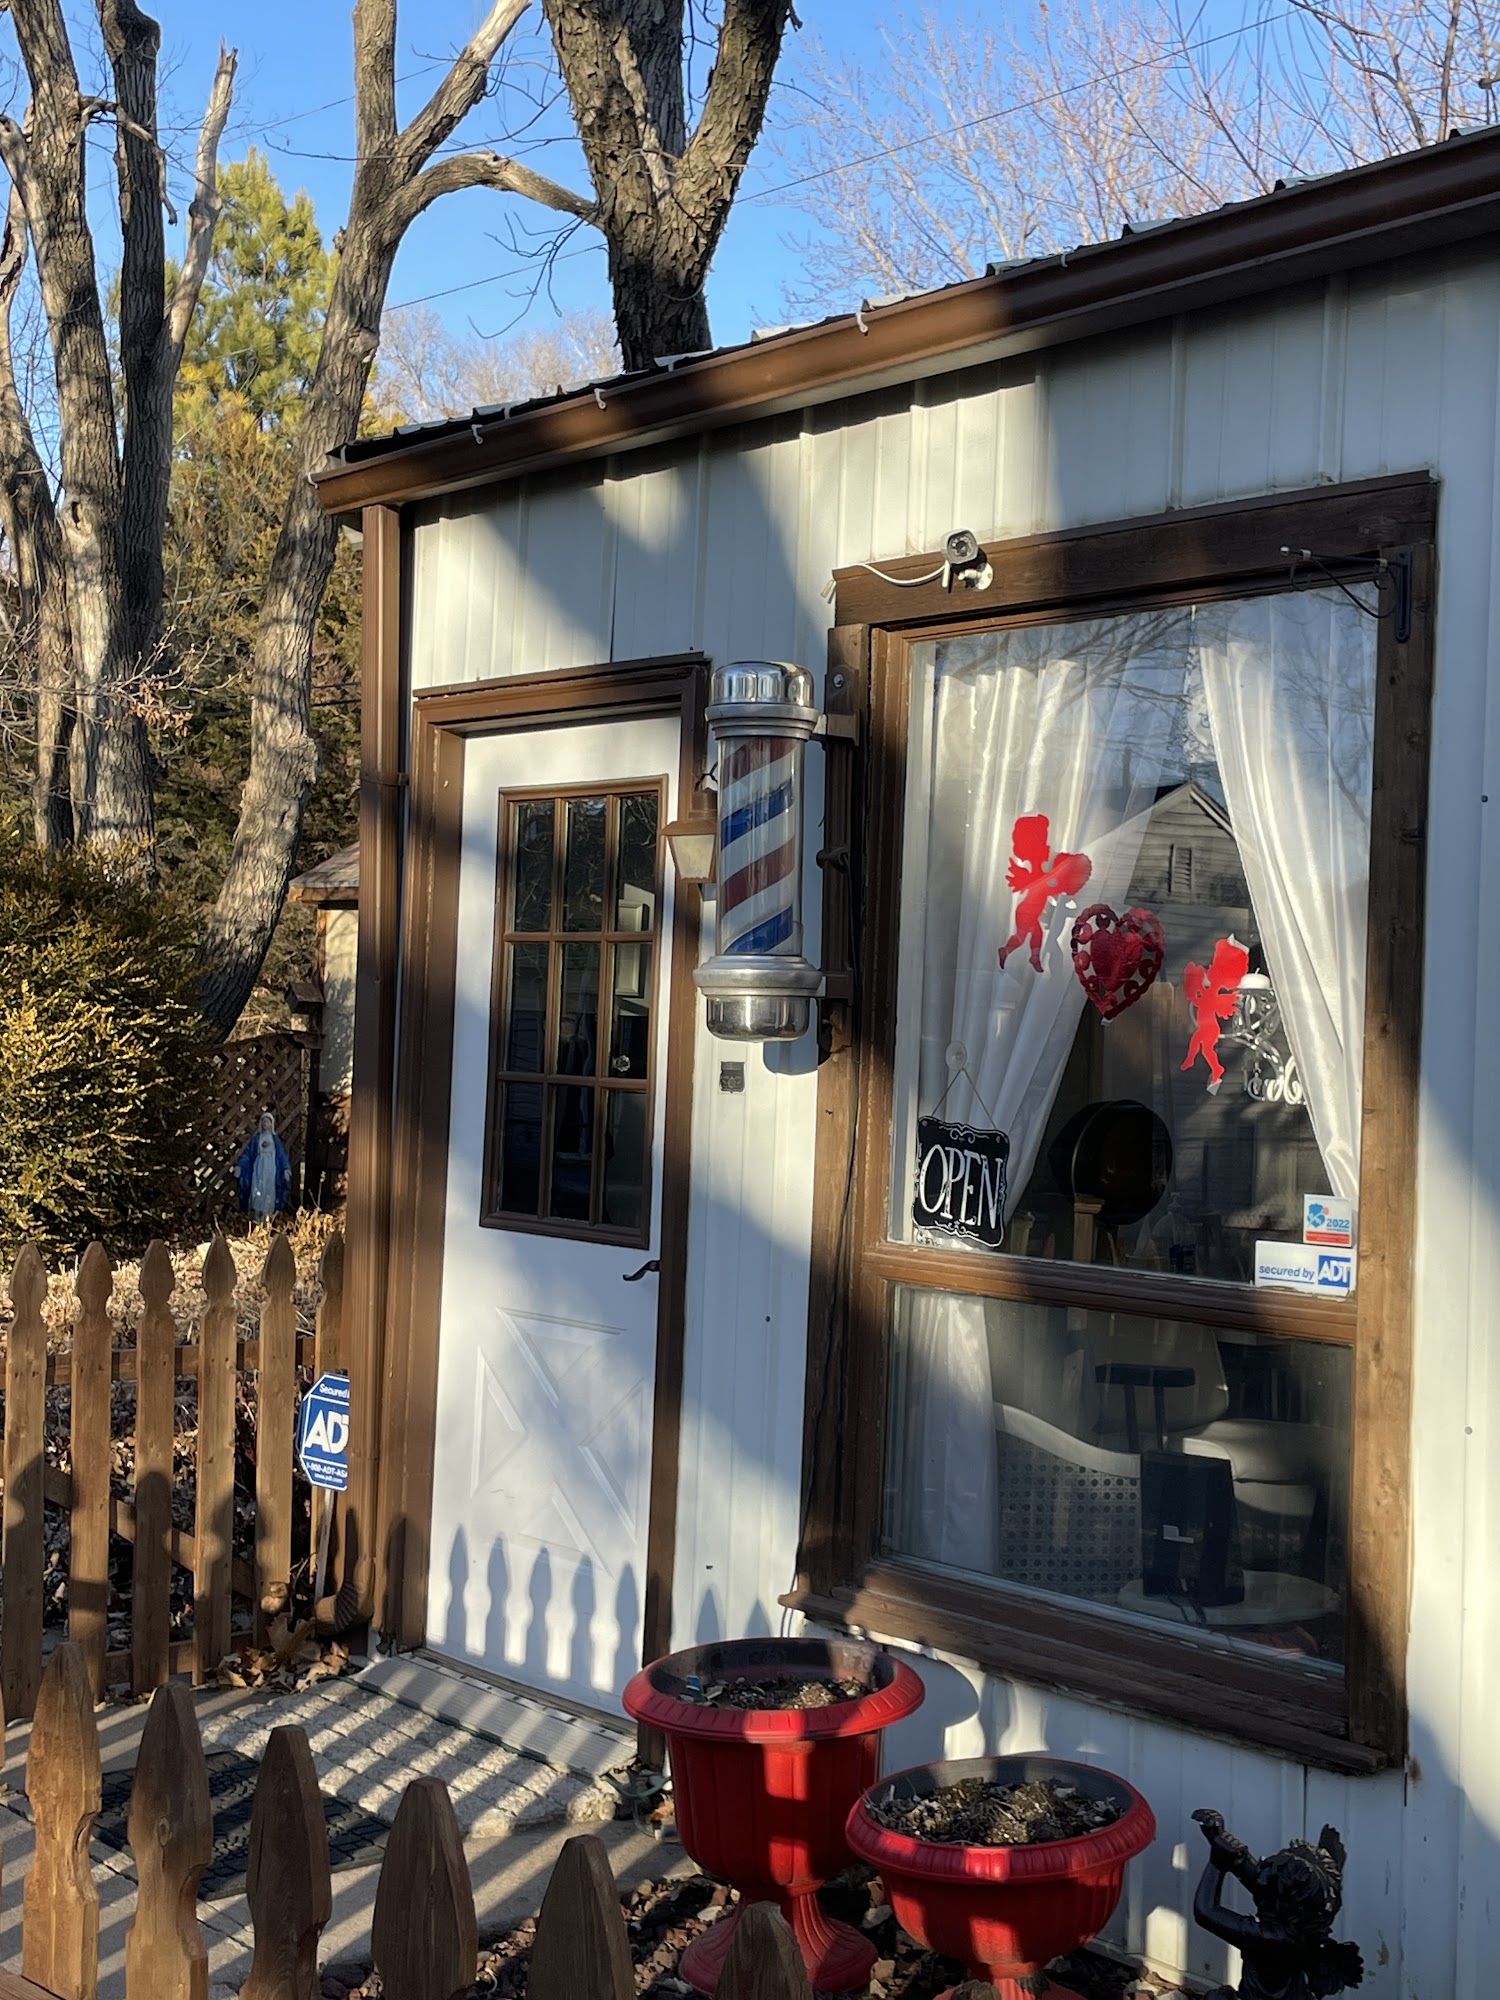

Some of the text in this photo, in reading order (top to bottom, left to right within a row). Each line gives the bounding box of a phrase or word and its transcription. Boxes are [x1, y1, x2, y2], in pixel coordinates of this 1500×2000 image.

[919, 1144, 1004, 1229] OPEN
[1326, 1218, 1350, 1229] 2022
[1258, 1259, 1351, 1284] secured by ADT
[319, 1383, 347, 1398] Secured
